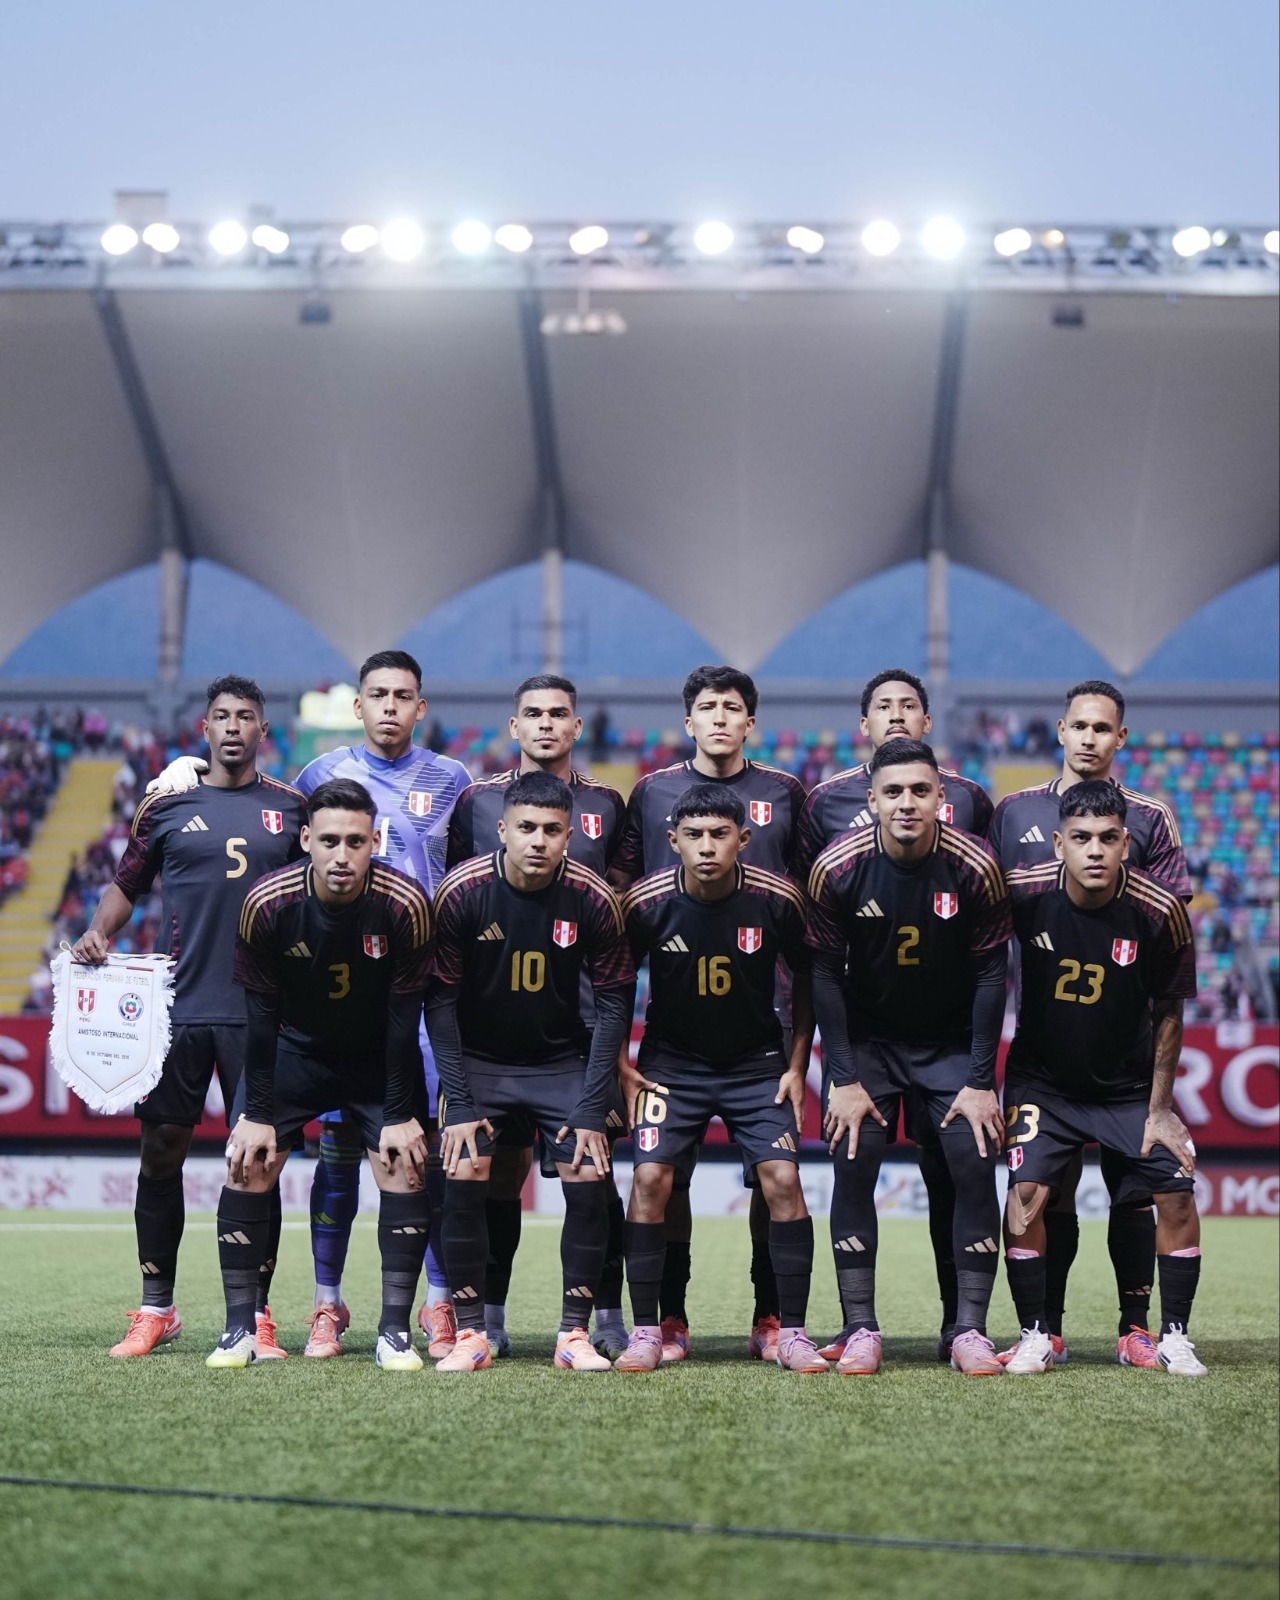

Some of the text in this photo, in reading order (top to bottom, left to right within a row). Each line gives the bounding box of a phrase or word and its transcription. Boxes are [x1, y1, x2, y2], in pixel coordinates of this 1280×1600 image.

[226, 838, 248, 878] 5
[897, 926, 920, 965] 2
[328, 963, 351, 999] 3
[511, 951, 546, 992] 10
[697, 956, 732, 996] 16
[1054, 958, 1105, 1005] 23
[78, 1028, 139, 1041] AMISTOSO INTERNACIONAL
[636, 1085, 670, 1125] 16
